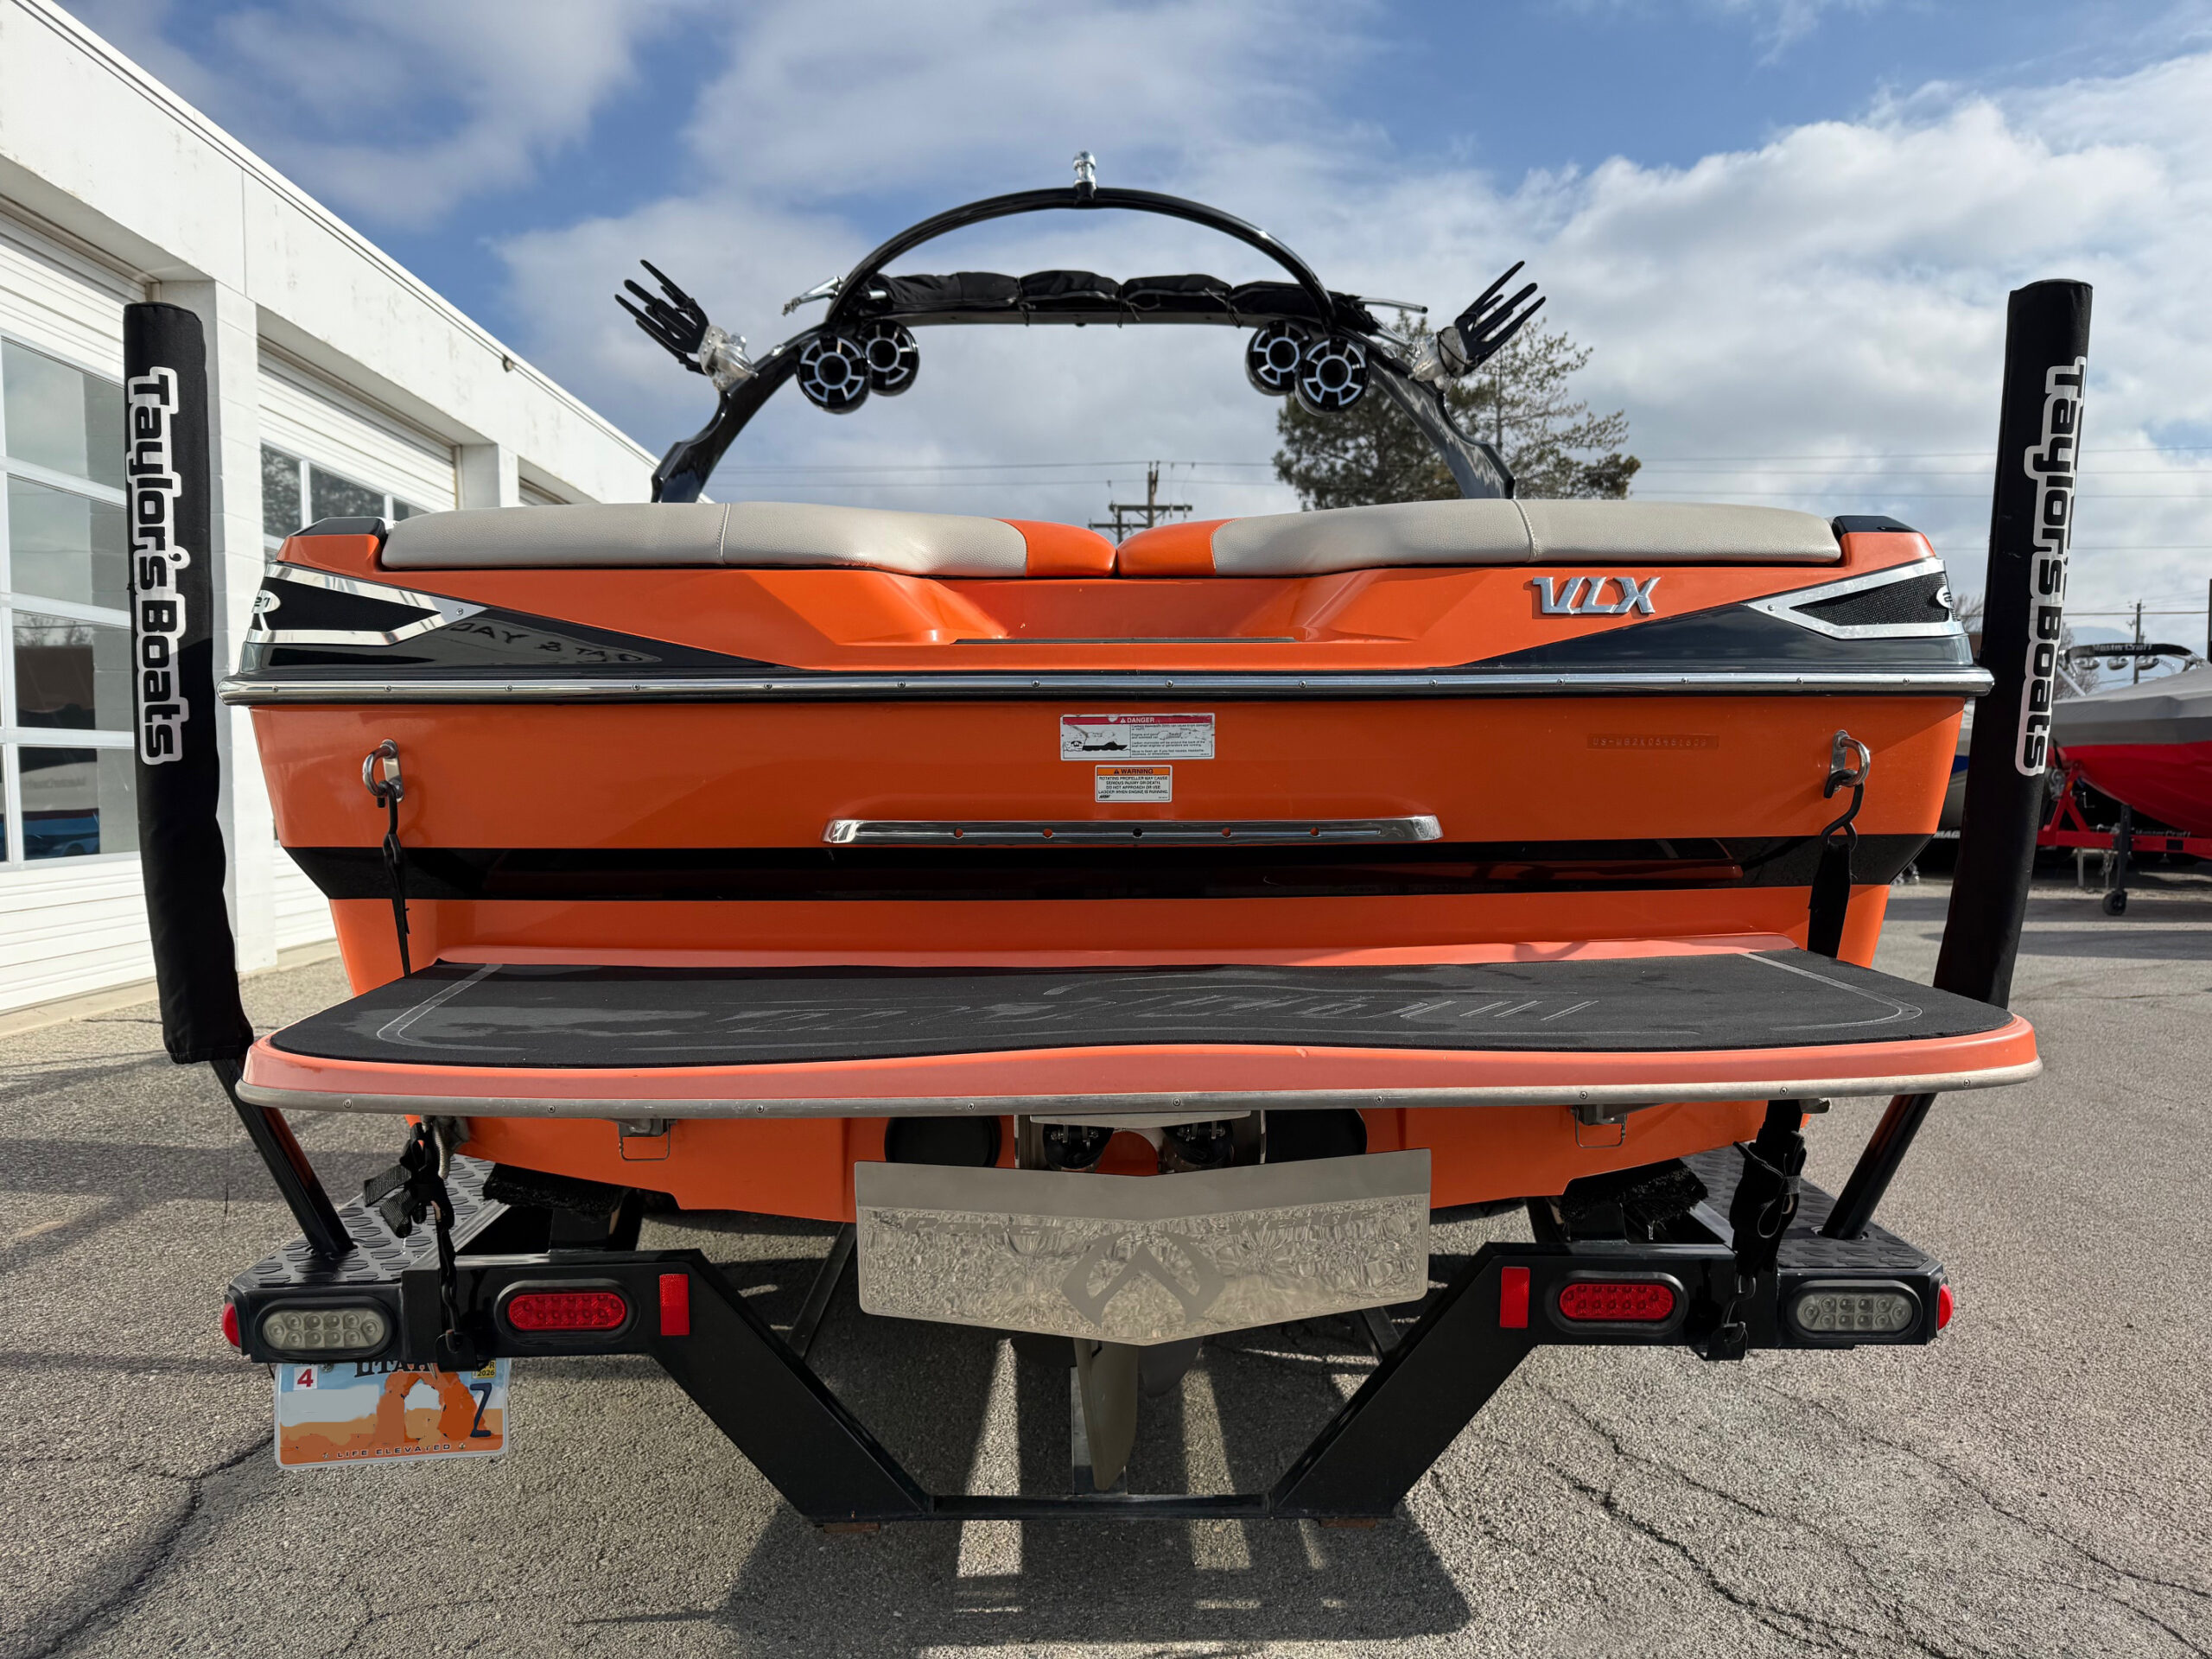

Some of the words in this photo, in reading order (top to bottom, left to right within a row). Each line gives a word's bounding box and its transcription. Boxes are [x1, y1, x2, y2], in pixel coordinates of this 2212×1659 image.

[128, 372, 185, 592] Taylor's
[2029, 359, 2086, 598] Taylor's
[1533, 576, 1662, 613] VLX
[138, 598, 184, 763] Boats
[2021, 603, 2063, 772] Boats
[296, 1369, 315, 1388] 4
[469, 1382, 493, 1438] Z
[337, 1449, 368, 1458] LIFE
[375, 1444, 451, 1455] ELEVATED
